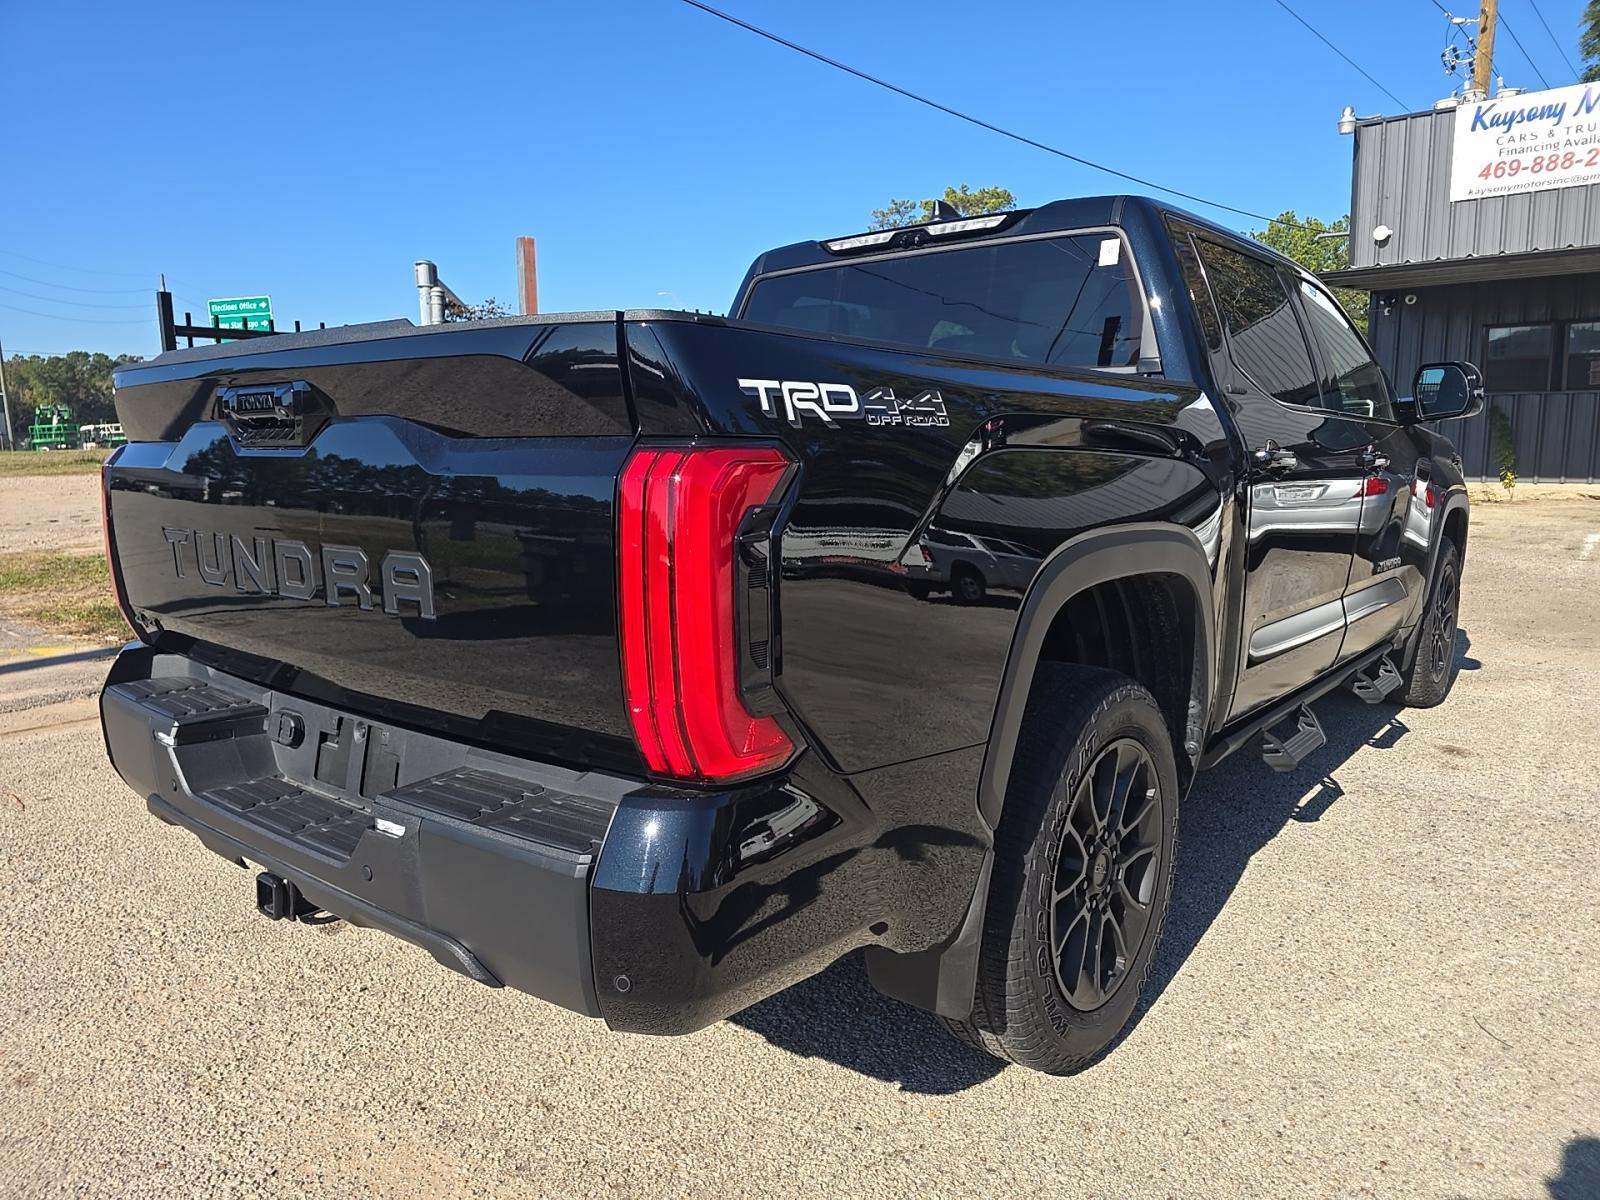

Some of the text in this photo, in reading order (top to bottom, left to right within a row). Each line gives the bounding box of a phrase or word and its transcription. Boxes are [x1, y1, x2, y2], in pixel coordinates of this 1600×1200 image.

[1470, 101, 1567, 134] Kaysony
[1496, 131, 1538, 146] CARS
[1547, 129, 1555, 138] &
[1498, 140, 1560, 157] Financing
[211, 301, 257, 312] Elections Office
[239, 394, 274, 410] TOYOTA
[737, 378, 861, 427] TRD
[866, 413, 950, 427] OFF ROAD
[161, 526, 437, 621] TUNDRA
